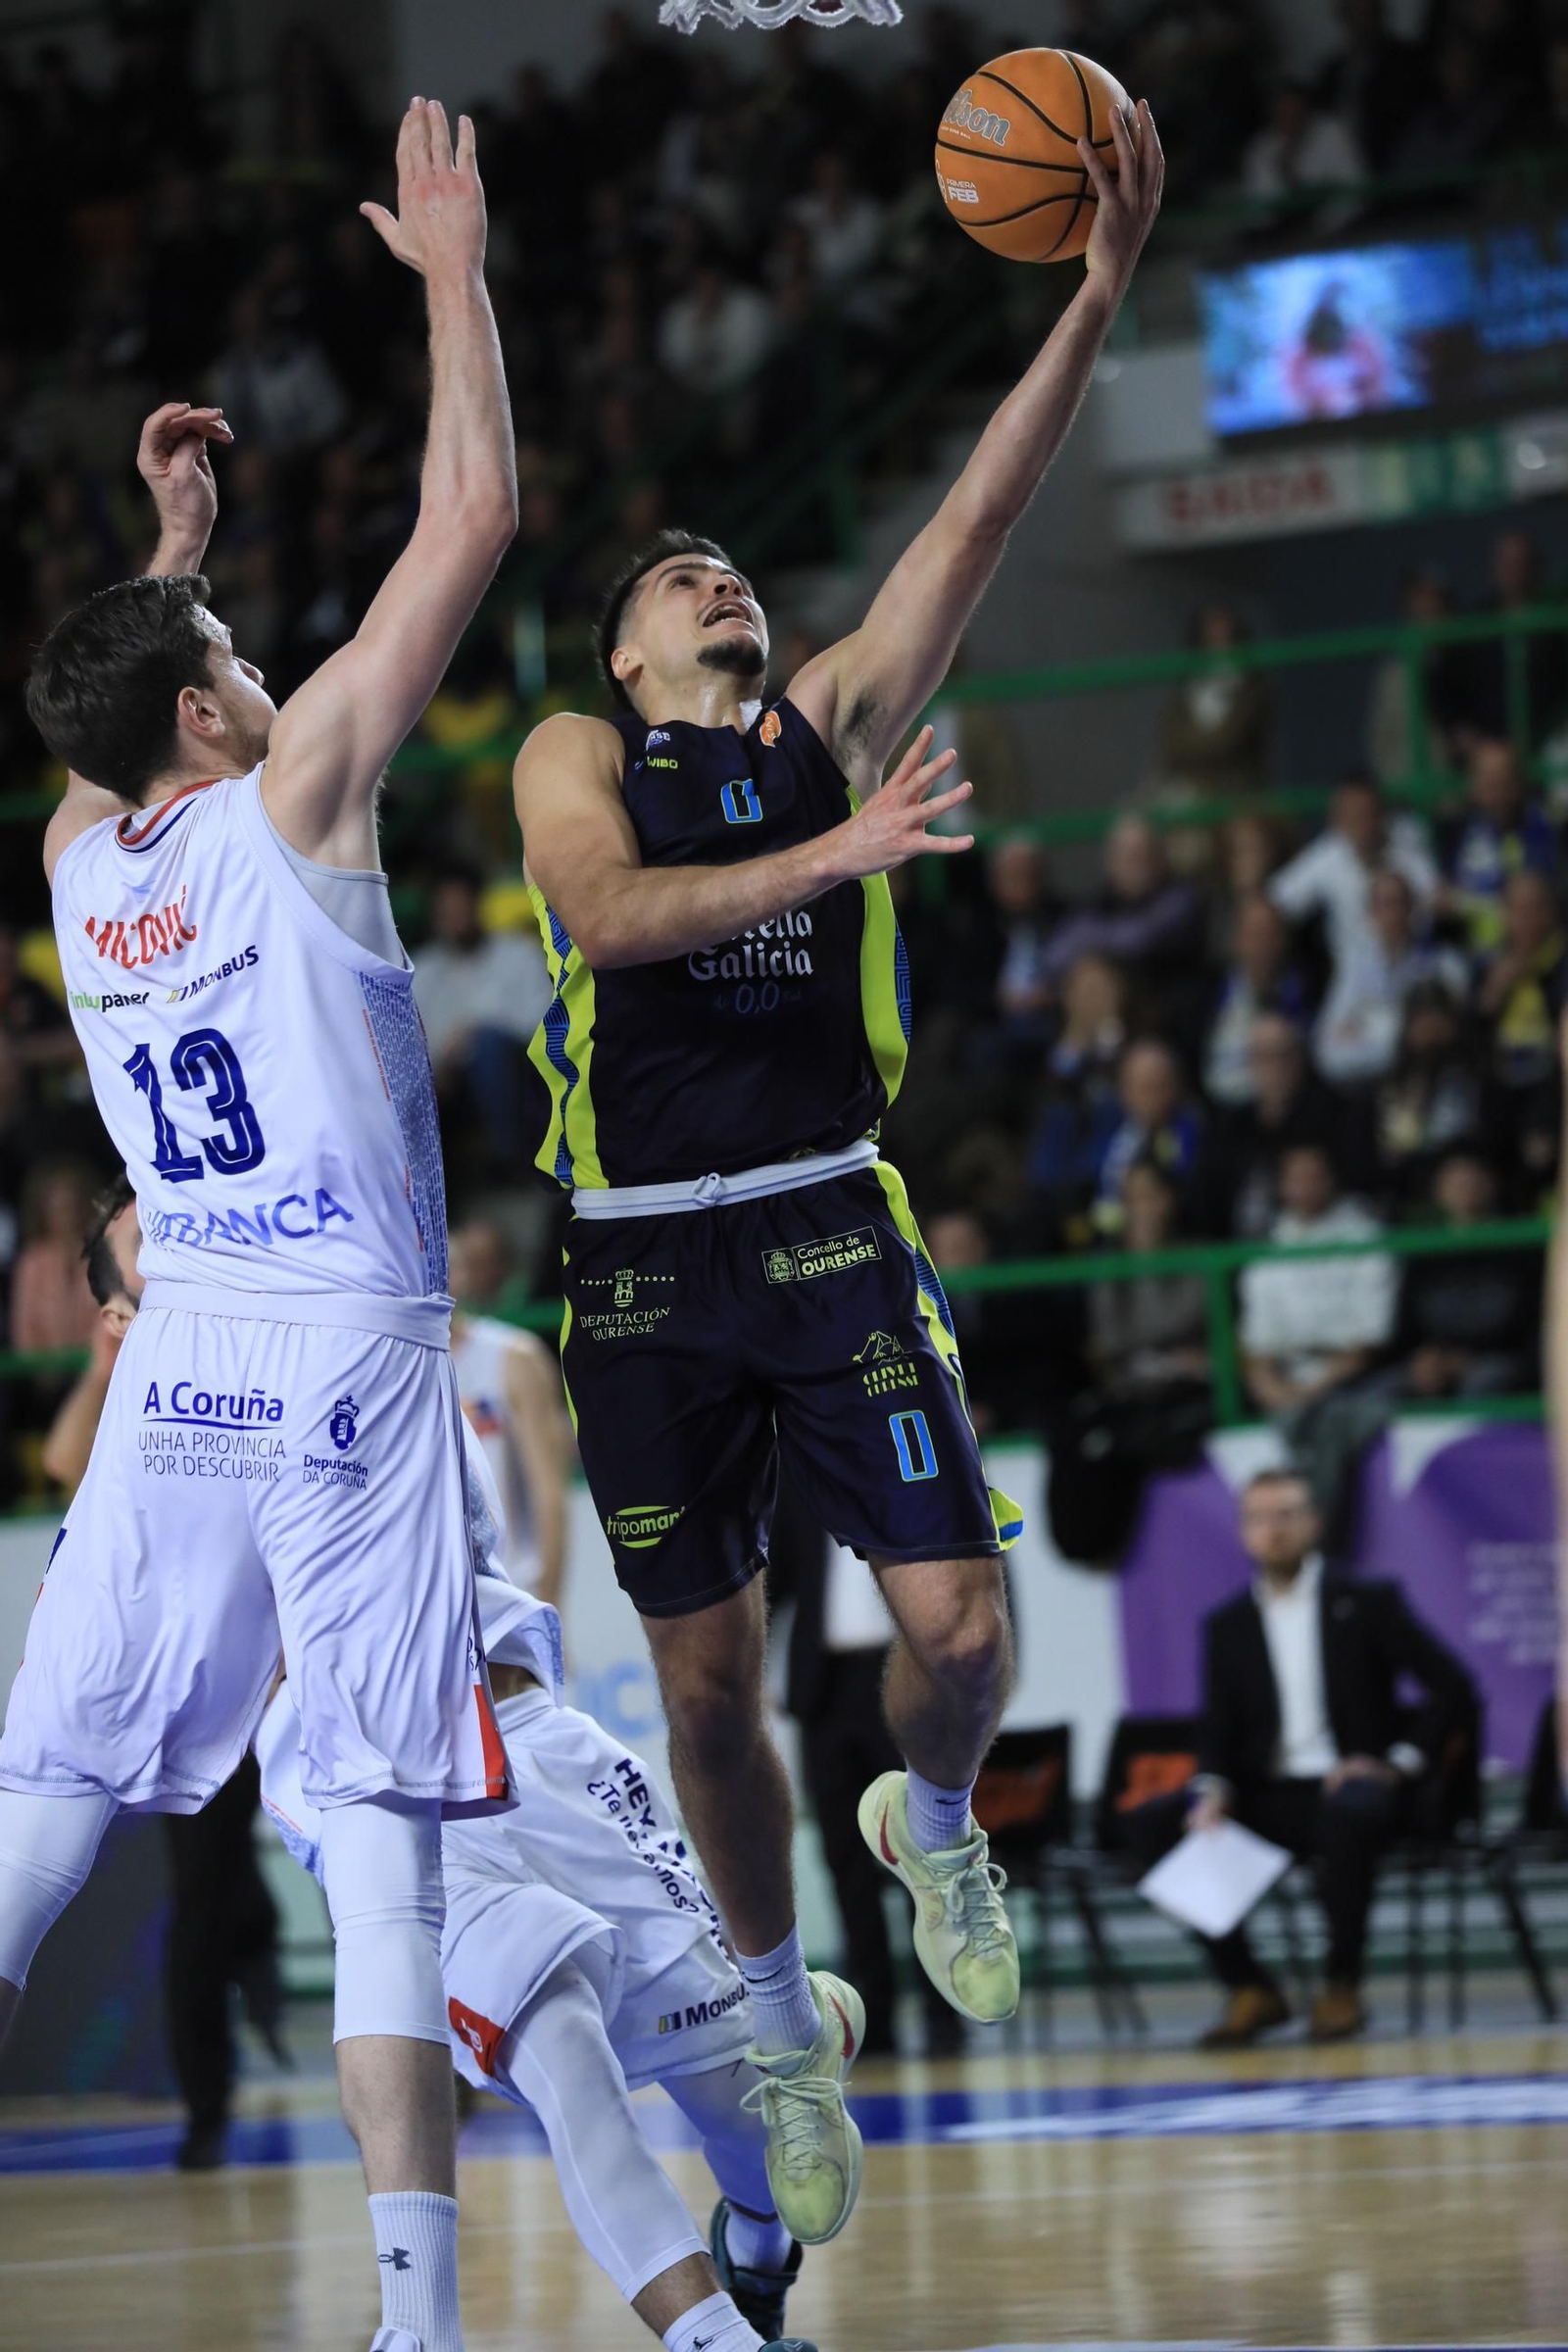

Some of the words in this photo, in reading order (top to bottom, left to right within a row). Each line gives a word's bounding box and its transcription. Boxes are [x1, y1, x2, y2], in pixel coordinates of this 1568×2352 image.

[943, 89, 1010, 146] ilson
[946, 178, 976, 188] PRIMERA
[948, 186, 979, 203] FEB
[688, 941, 813, 981] Galicia
[122, 1027, 266, 1183] 13
[797, 1241, 843, 1259] Concello
[846, 1236, 859, 1248] de
[802, 1244, 877, 1276] OURENSE
[579, 1306, 671, 1328] DEPUTACIÓN
[592, 1322, 656, 1341] OURENSE
[143, 1381, 162, 1414] A
[171, 1381, 284, 1421] Coruña
[138, 1431, 186, 1452] UNHA
[192, 1432, 286, 1459] PROVINCIA
[889, 1410, 939, 1482] 0
[144, 1454, 177, 1476] POR
[182, 1455, 280, 1483] DESCUBRIR
[304, 1454, 368, 1478] Deputación
[302, 1470, 320, 1484] DA
[323, 1470, 368, 1492] CORUÑA
[587, 1781, 621, 1814] ¿Te
[686, 1982, 750, 2028] MONBU
